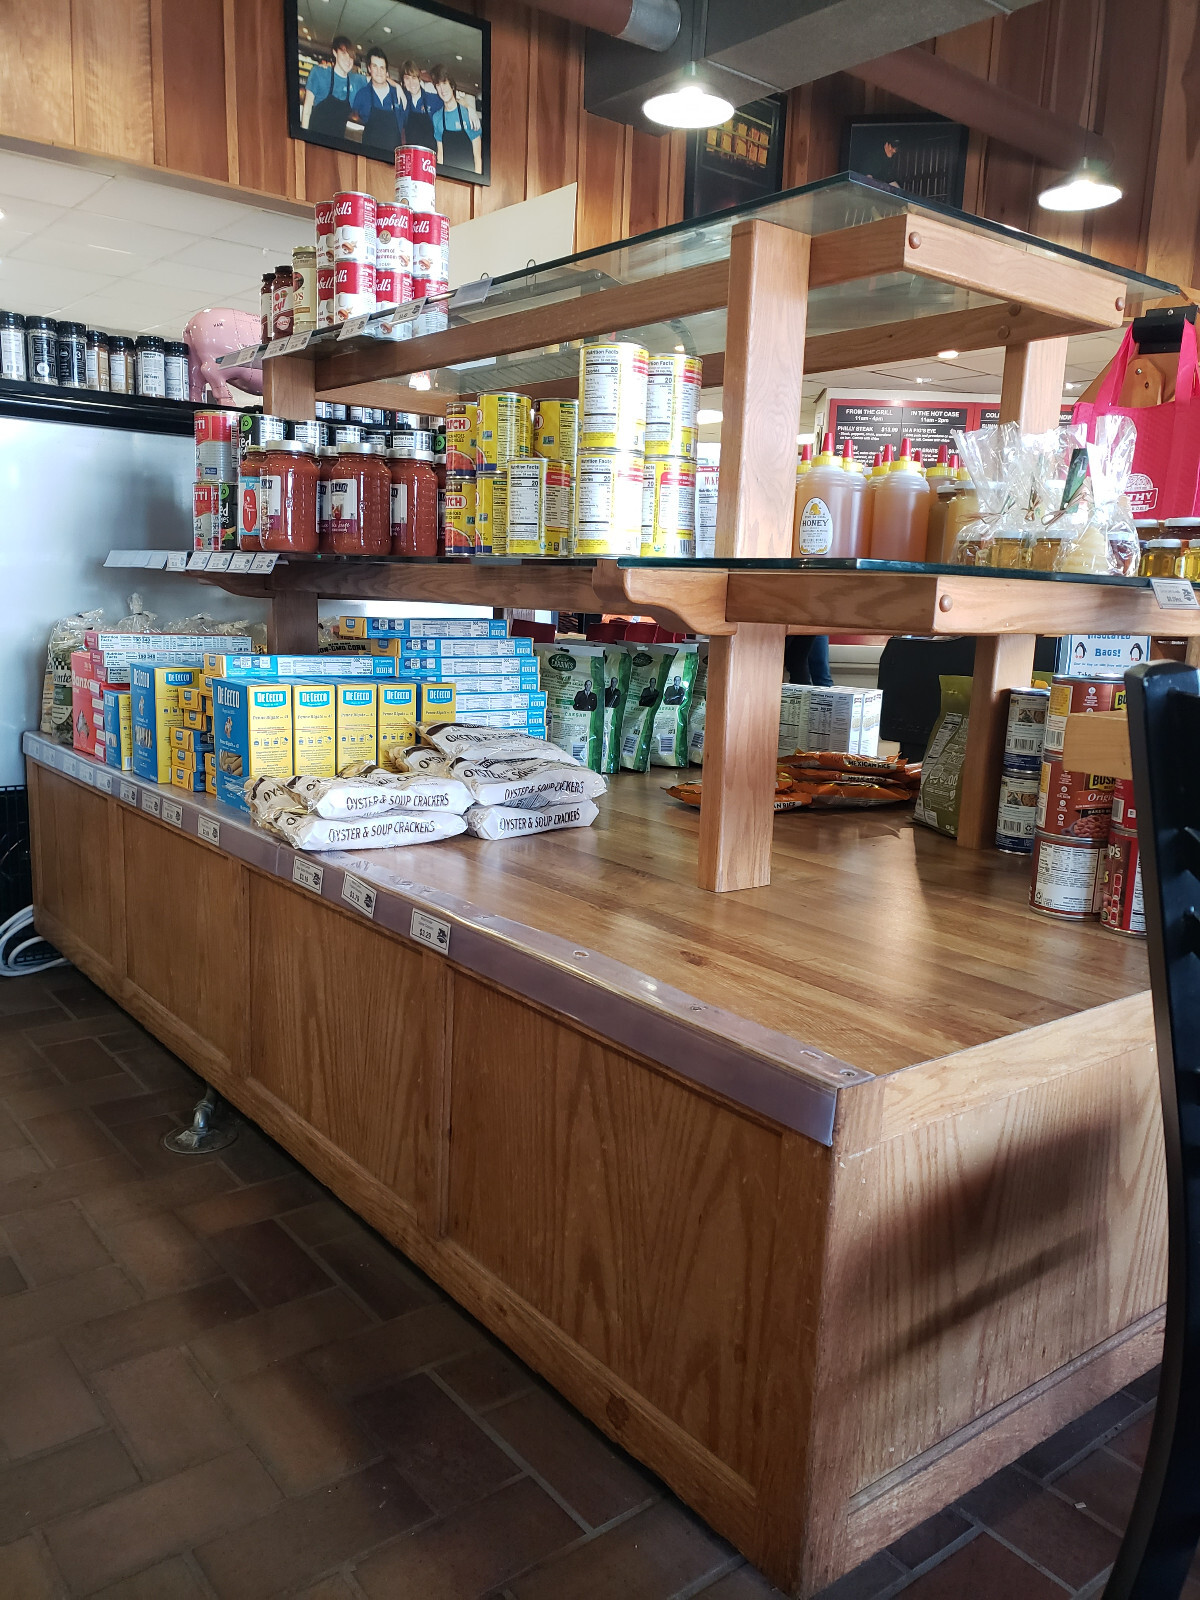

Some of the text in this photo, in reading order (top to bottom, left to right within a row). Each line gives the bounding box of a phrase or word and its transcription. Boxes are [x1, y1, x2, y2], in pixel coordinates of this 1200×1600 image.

[802, 518, 829, 527] HONEY
[217, 685, 240, 709] DE CECCO
[257, 692, 284, 703] DE CECCO
[301, 692, 328, 703] DE CECCO
[345, 691, 370, 701] DE CECCO
[386, 690, 410, 700] DE CECCO
[429, 690, 451, 699] DE CECCO
[848, 760, 877, 769] MEXICAN
[554, 780, 585, 795] CRCKERS
[346, 794, 379, 811] OYSTER
[388, 794, 412, 807] SOUP
[413, 792, 450, 807] CRACKERS
[782, 801, 796, 809] RICE
[500, 808, 581, 831] OYSTER & SOUP CRACKERS
[328, 820, 436, 843] OYSTER & SOUP CRACKERS
